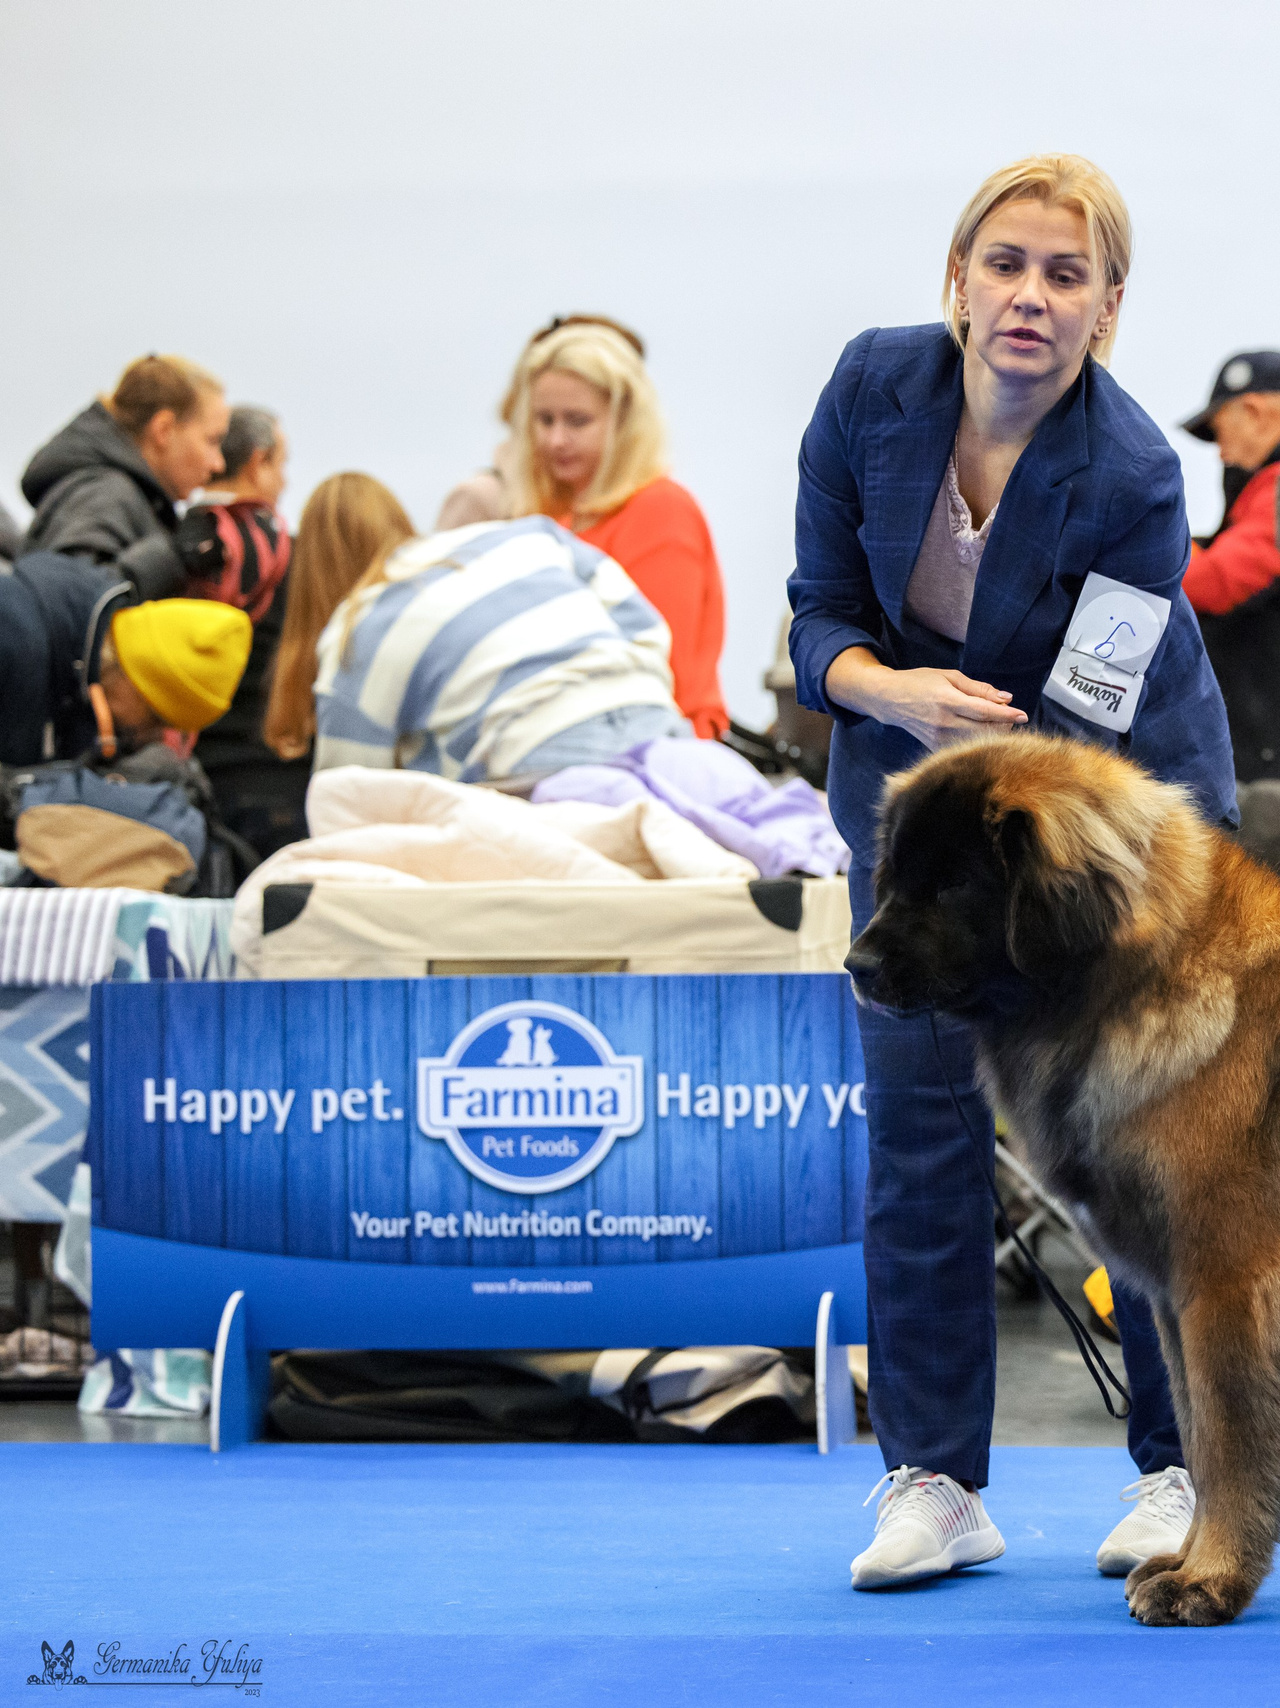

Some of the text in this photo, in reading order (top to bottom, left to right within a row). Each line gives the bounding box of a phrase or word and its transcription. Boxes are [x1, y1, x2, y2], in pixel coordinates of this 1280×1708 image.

[143, 1077, 404, 1135] Happy pet.
[442, 1076, 619, 1117] Farmina
[657, 1072, 810, 1129] Happy
[482, 1135, 580, 1157] Pet Foods
[351, 1209, 713, 1242] Your Pet Nutrition Company.
[471, 1278, 593, 1294] www.Farmina.com
